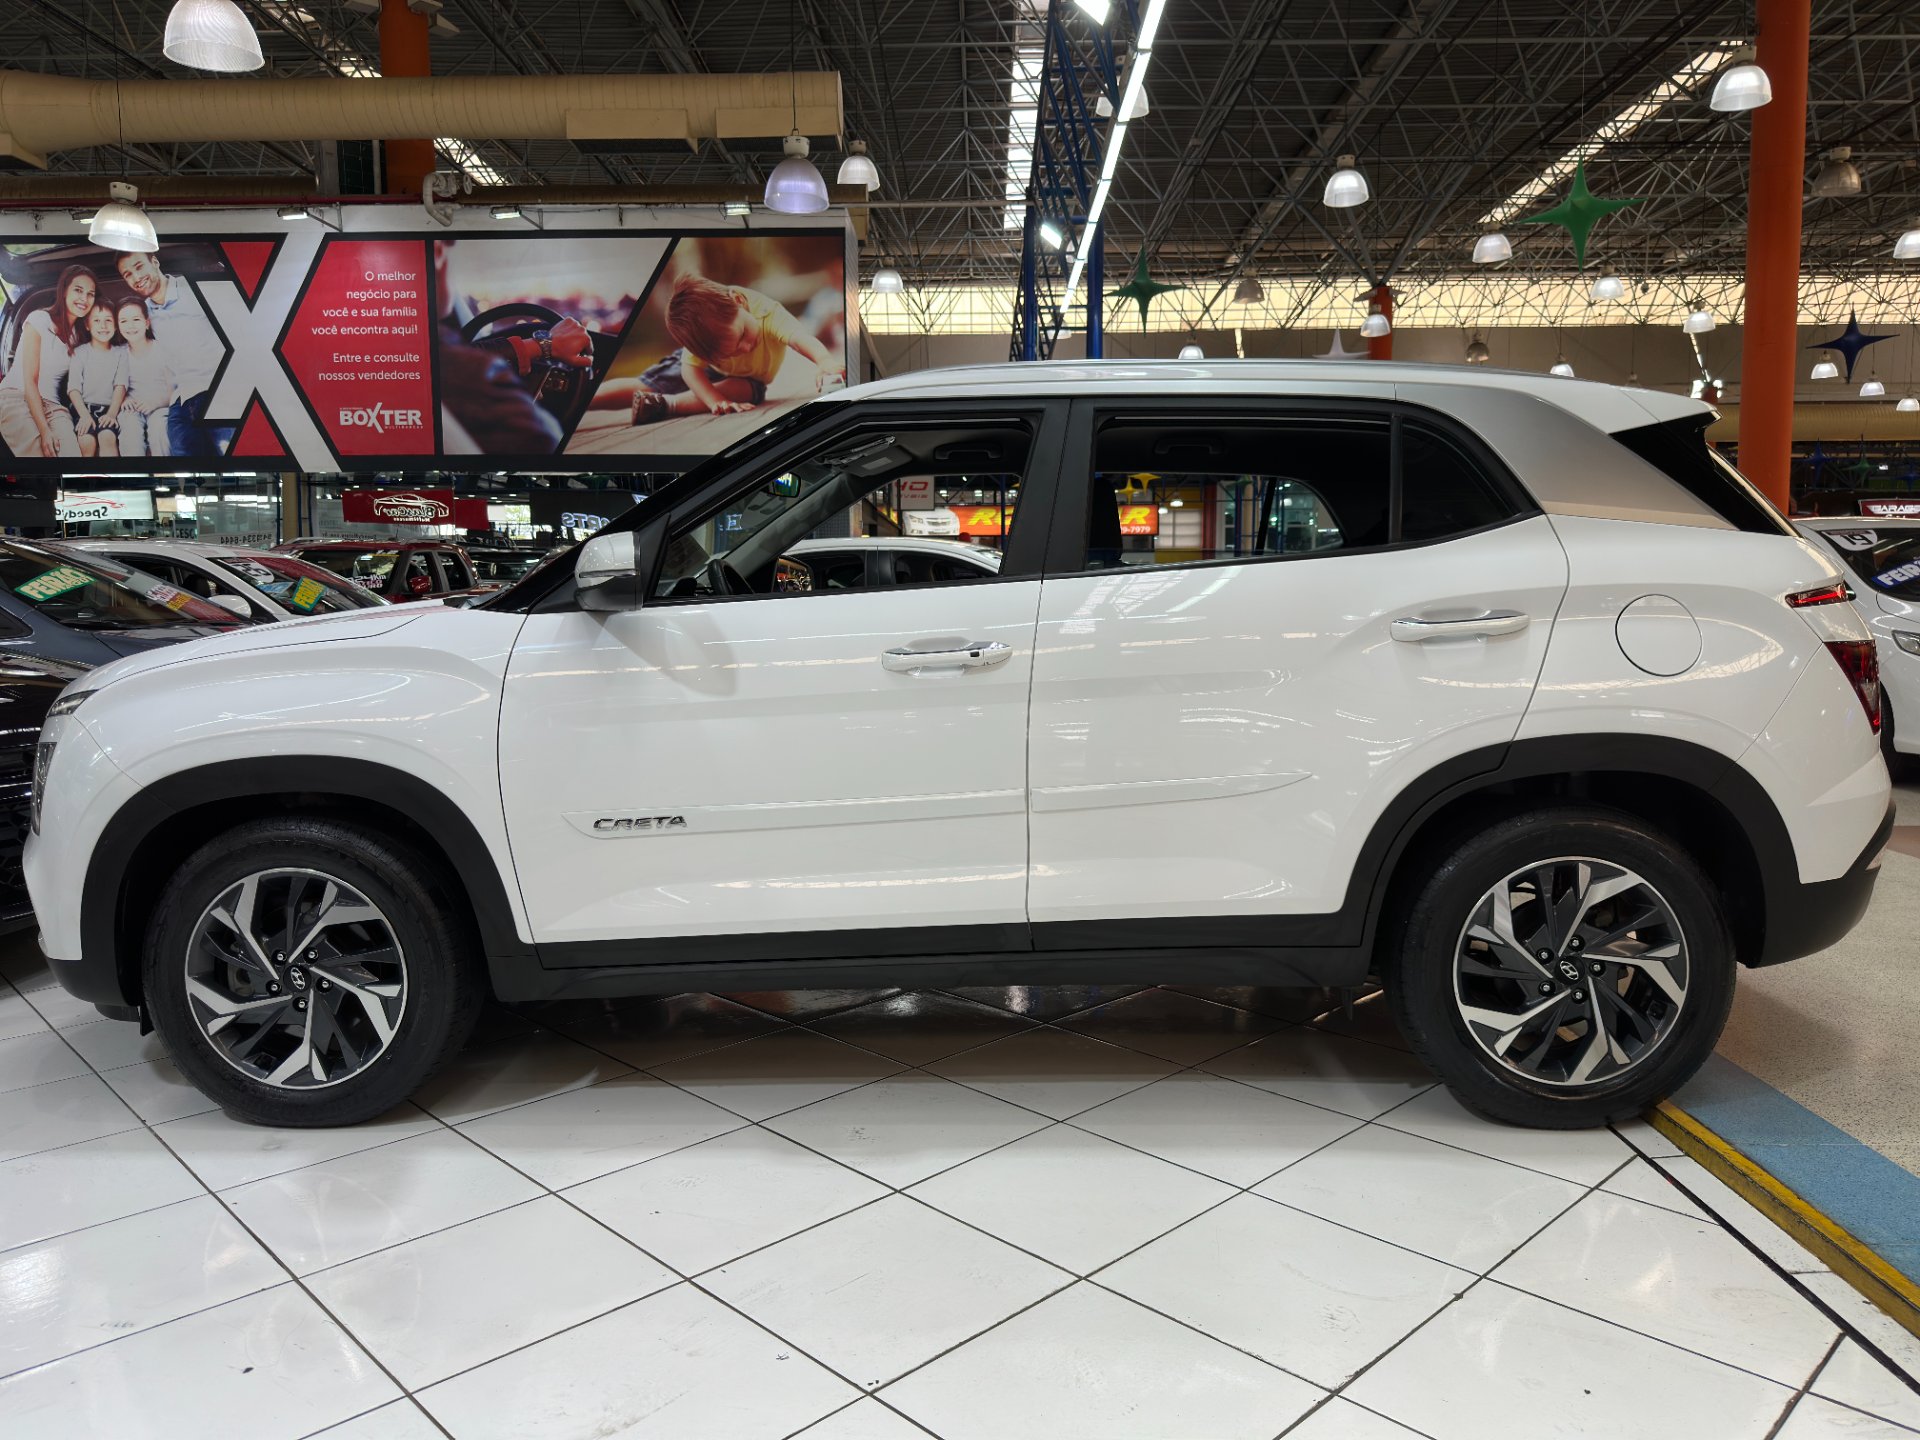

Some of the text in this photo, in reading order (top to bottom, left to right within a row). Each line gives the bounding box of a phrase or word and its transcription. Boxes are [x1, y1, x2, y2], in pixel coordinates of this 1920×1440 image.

[364, 271, 416, 281] O melhor
[346, 289, 417, 301] negócio para
[322, 306, 417, 317] você e sua família
[311, 325, 418, 336] você encontra aqui!
[333, 353, 420, 363] Entre e consulte
[318, 370, 421, 381] nossos vendedores
[340, 402, 423, 433] BOXTER
[593, 815, 688, 831] CRETA
